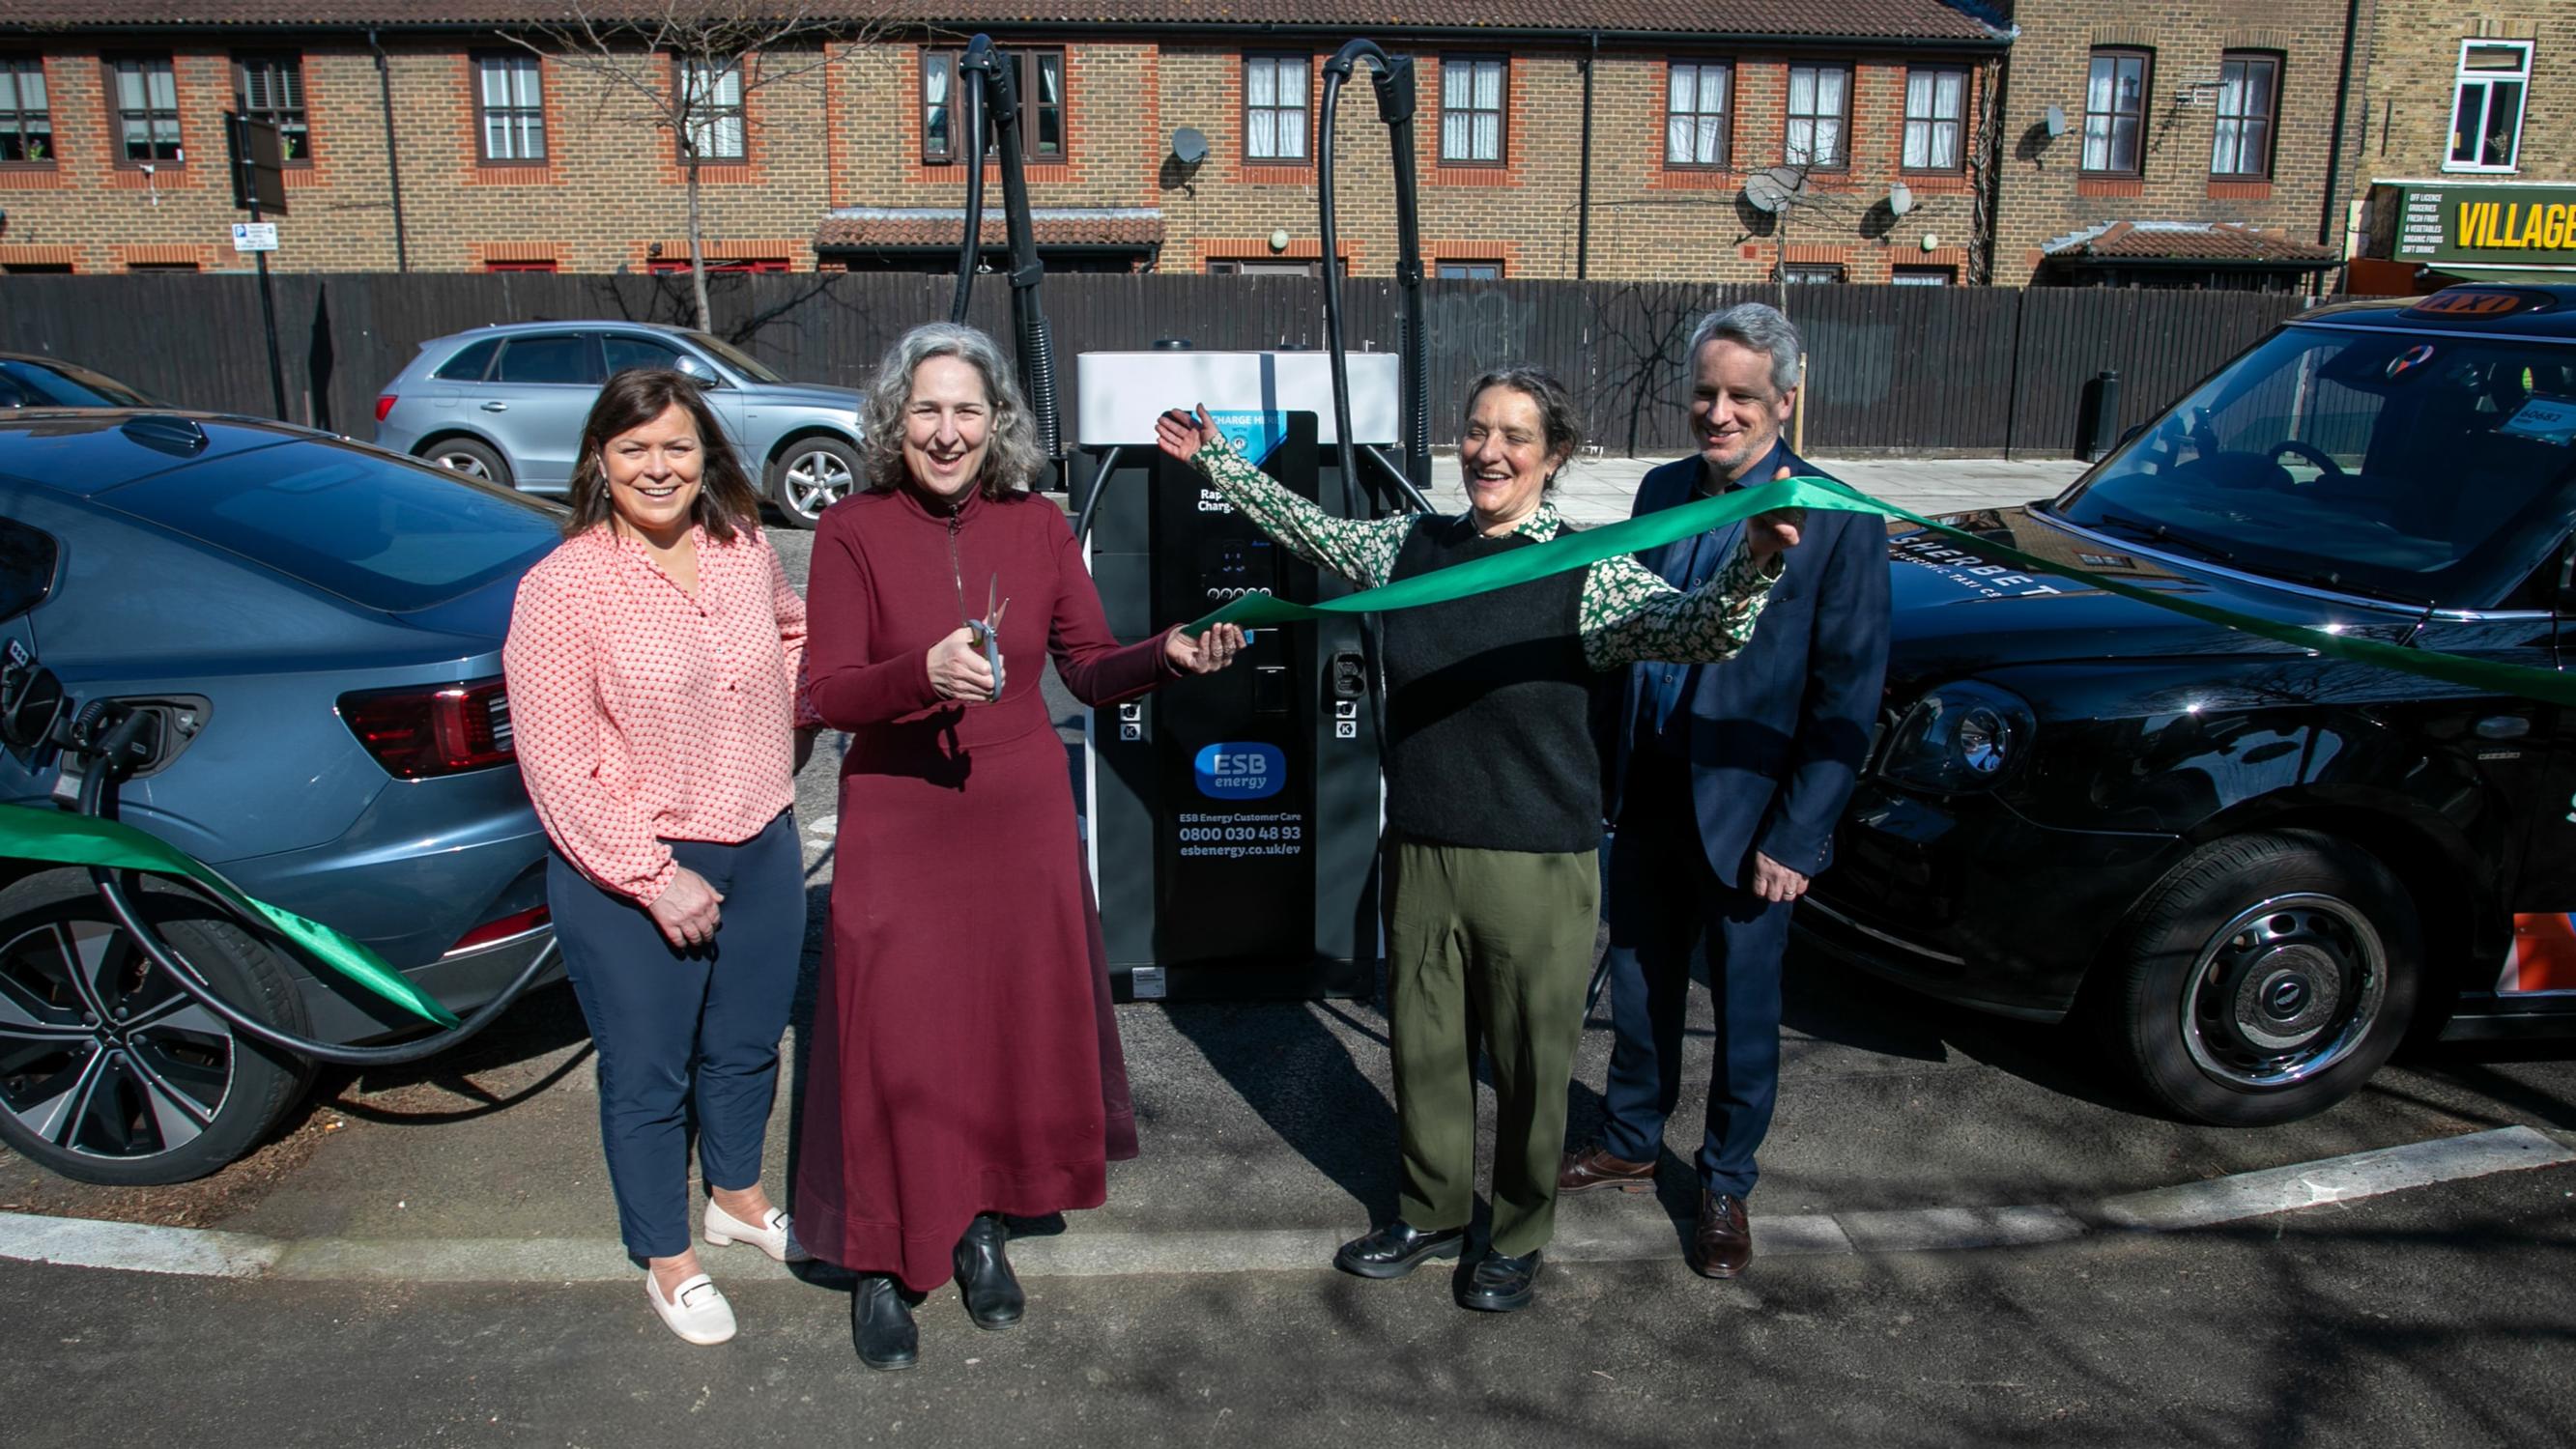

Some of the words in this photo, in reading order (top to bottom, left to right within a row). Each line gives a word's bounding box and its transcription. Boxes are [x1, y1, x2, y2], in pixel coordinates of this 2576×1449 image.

[2410, 193, 2420, 202] OFF
[2420, 194, 2444, 203] LICENCE
[2457, 201, 2576, 249] VILLAGE
[2426, 236, 2444, 244] FOODS
[2416, 245, 2435, 254] DRINKS
[2418, 294, 2511, 310] TAXI
[1200, 489, 1222, 501] Rap
[1888, 536, 2062, 596] SHERBET
[1948, 574, 1983, 587] TAXI
[1126, 727, 1134, 736] K
[1341, 724, 1350, 734] K
[1214, 753, 1267, 775] ESB
[1215, 777, 1268, 789] energy
[1179, 813, 1198, 822] ESB
[1200, 813, 1233, 824] Energy
[1234, 812, 1279, 822] Customer
[1280, 812, 1302, 821] Care
[1179, 827, 1221, 840] 0800
[1225, 827, 1255, 840] 030
[1258, 827, 1279, 839] 48
[1281, 826, 1301, 839] 93
[1180, 843, 1301, 859] esbenergy.co.uk/ev
